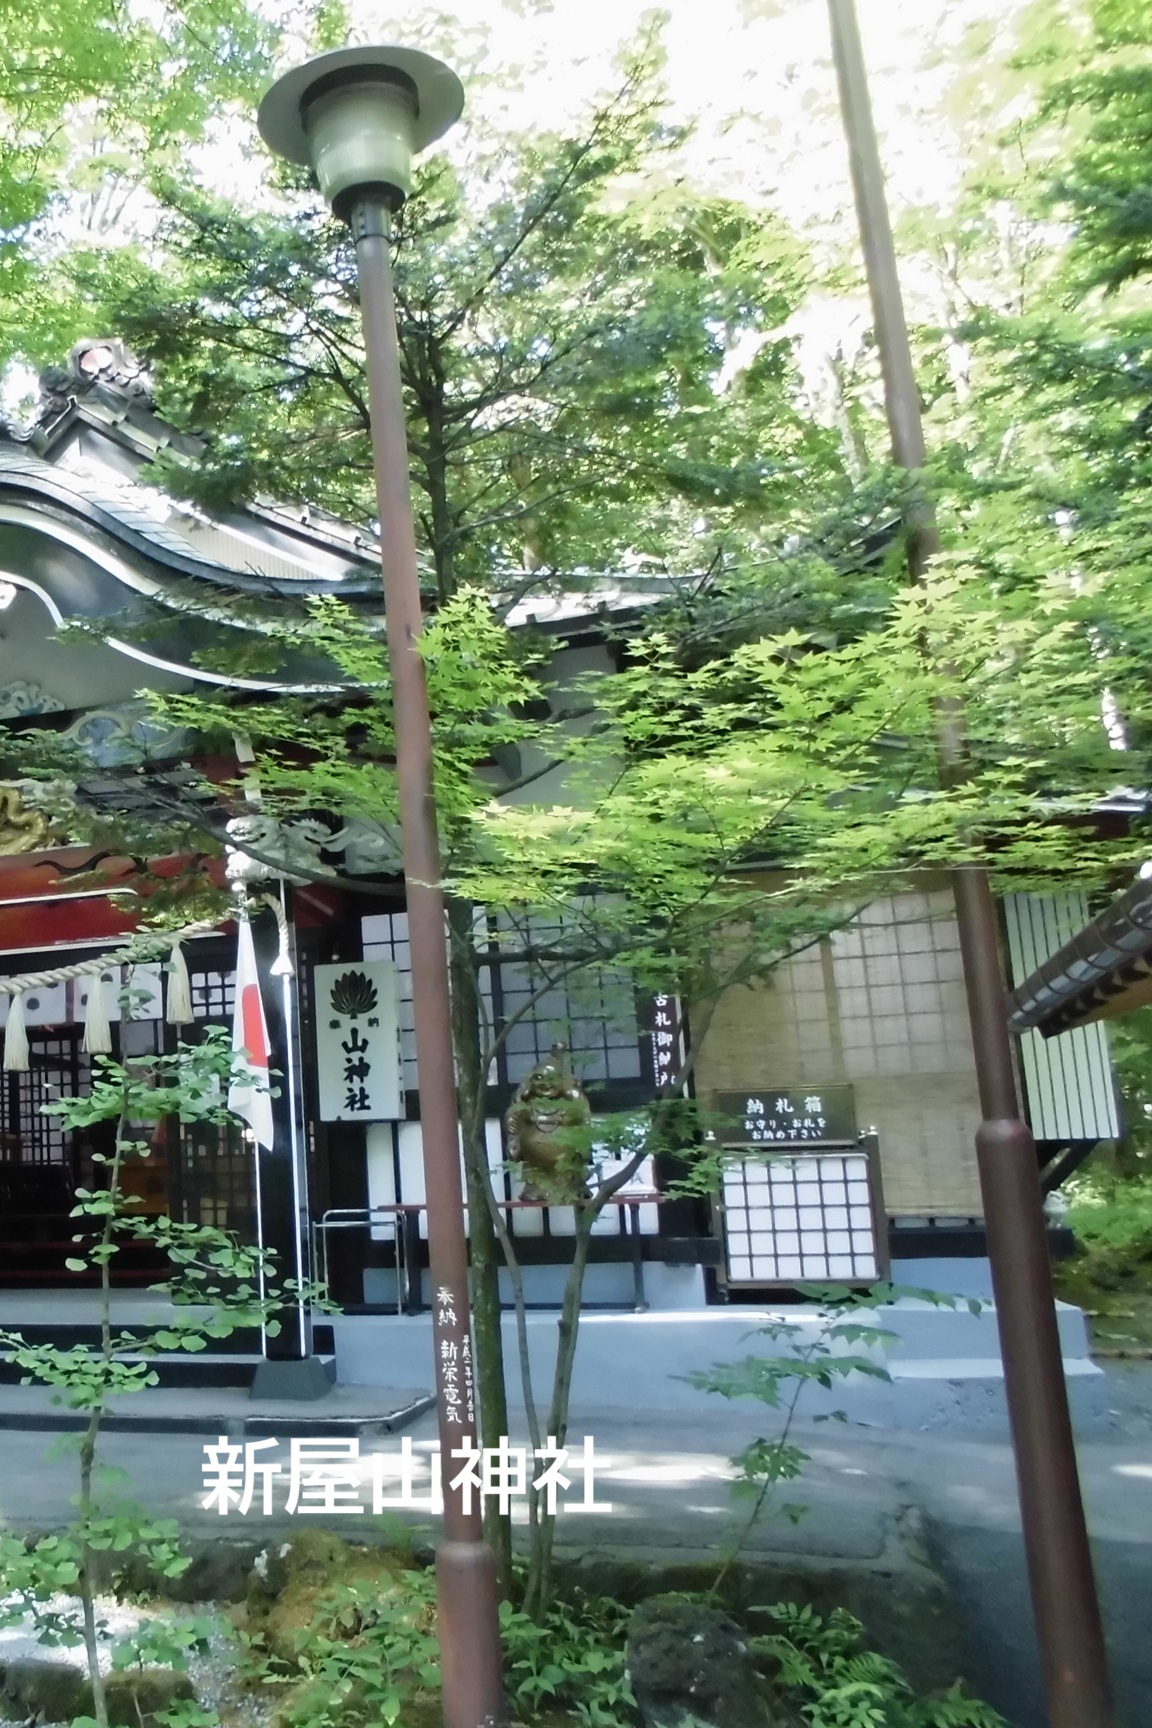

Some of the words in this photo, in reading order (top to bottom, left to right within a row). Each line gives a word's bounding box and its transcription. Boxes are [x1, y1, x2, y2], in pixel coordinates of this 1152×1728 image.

[341, 1026, 372, 1112] 山神社
[745, 1095, 822, 1115] 納札箱
[751, 1129, 822, 1140] お納め下さい
[436, 1286, 458, 1326] 奉納
[440, 1339, 462, 1424] 新栄電気
